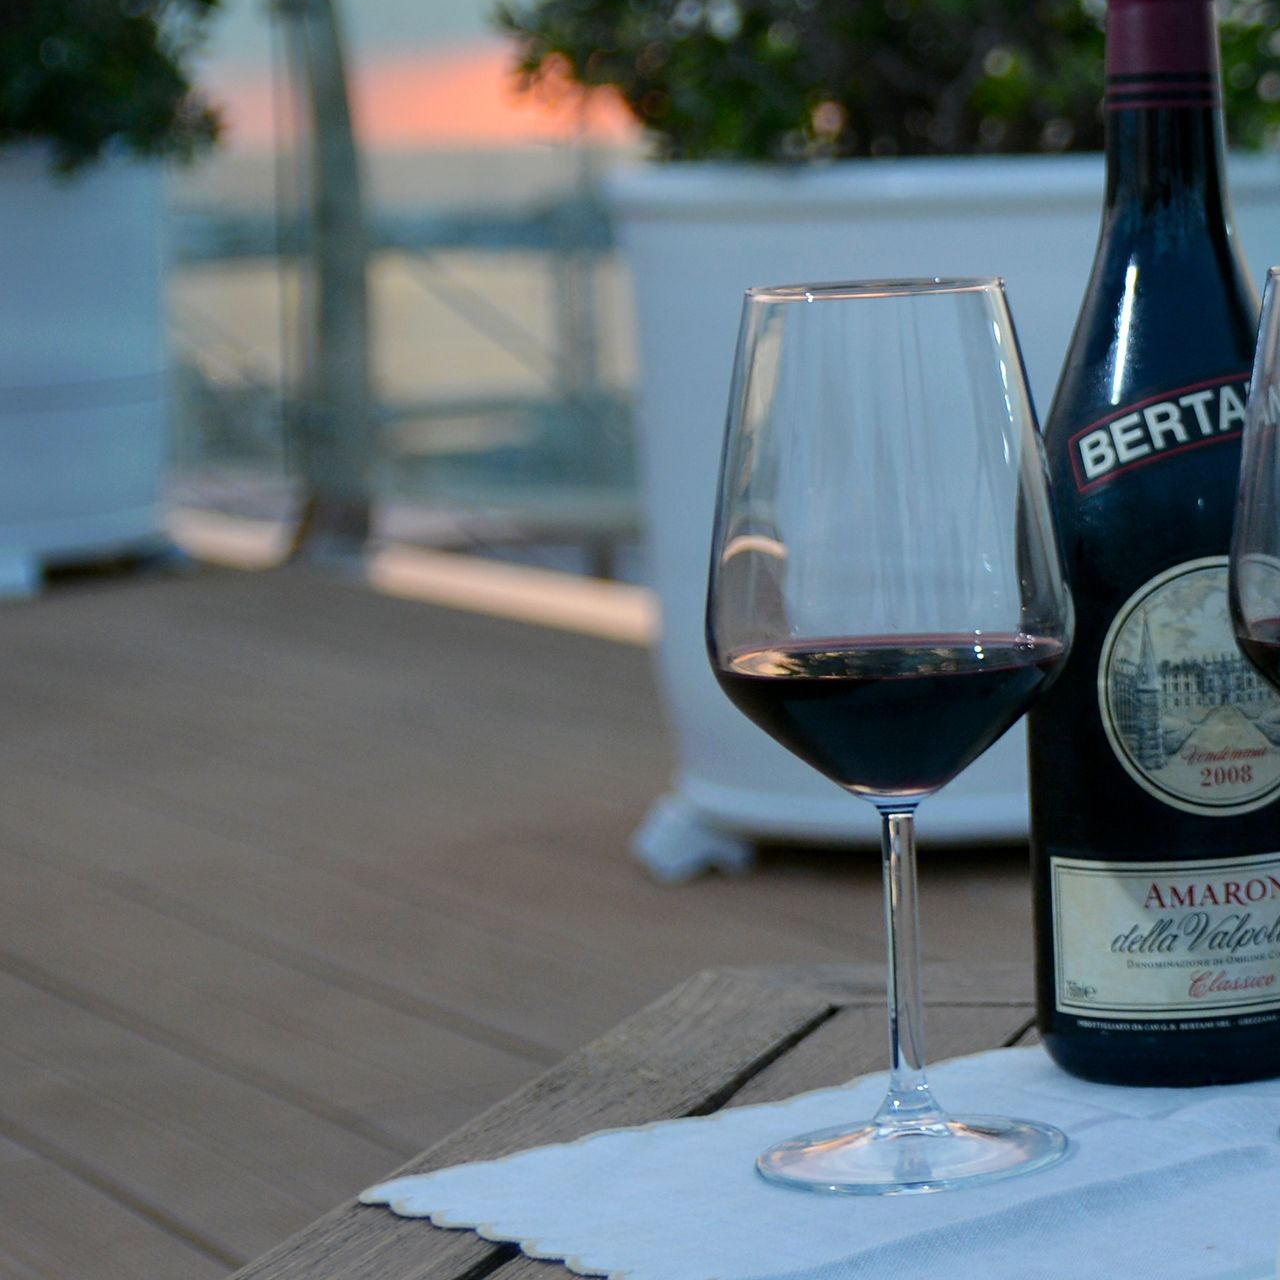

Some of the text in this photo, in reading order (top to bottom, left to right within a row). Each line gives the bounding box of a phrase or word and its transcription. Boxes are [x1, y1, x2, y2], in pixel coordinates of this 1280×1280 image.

[1200, 764, 1253, 787] 2008
[1110, 919, 1179, 954] della
[1188, 970, 1276, 999] Classico
